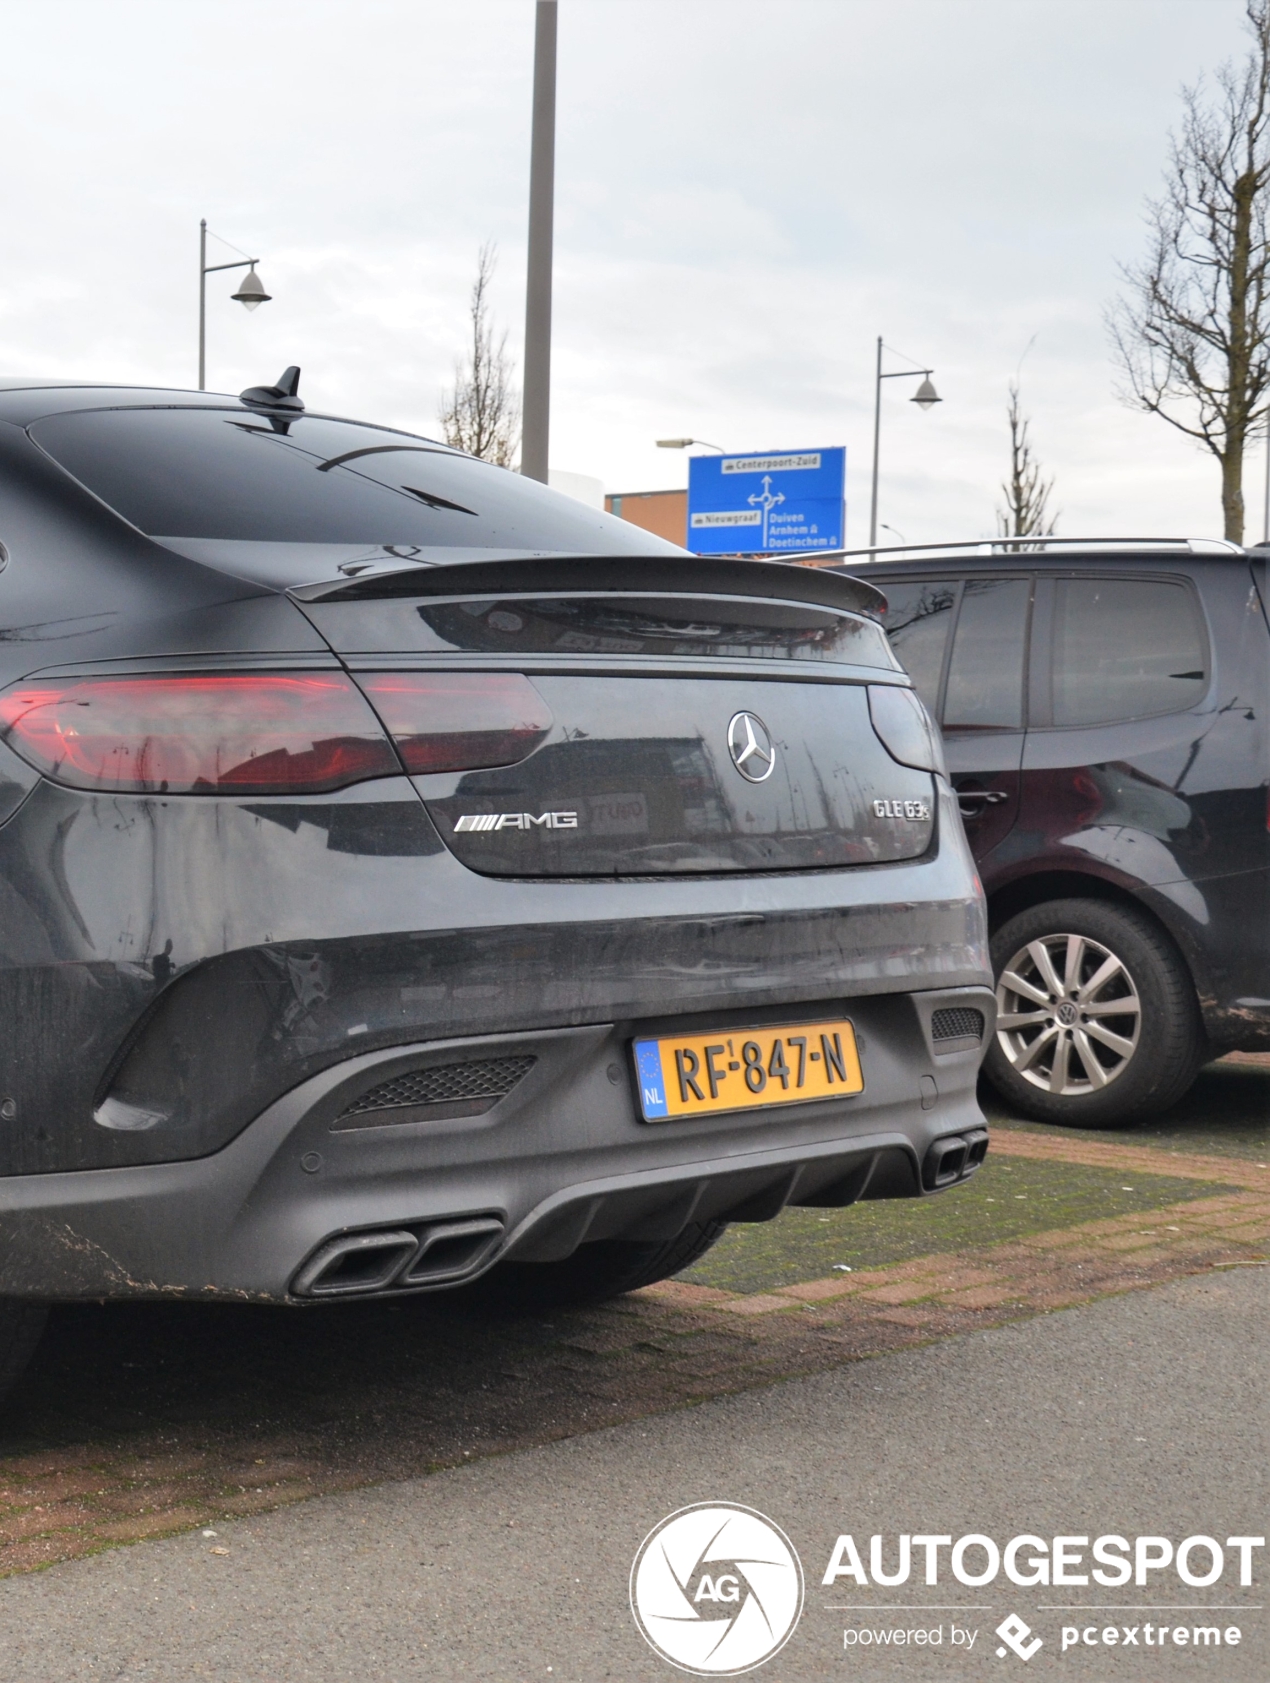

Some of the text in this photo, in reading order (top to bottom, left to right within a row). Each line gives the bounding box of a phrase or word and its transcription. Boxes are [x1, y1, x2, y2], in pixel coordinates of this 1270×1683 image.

[736, 456, 818, 470] Centerpoort-Zuid
[705, 513, 758, 524] Nieuwgraaf
[770, 513, 804, 523] Duiven
[770, 525, 808, 535] Arnhem
[769, 537, 828, 548] Doetinchem
[873, 799, 903, 818] GLE
[494, 811, 578, 831] AMG
[674, 1032, 848, 1103] RF-847-N
[645, 1088, 663, 1105] NL
